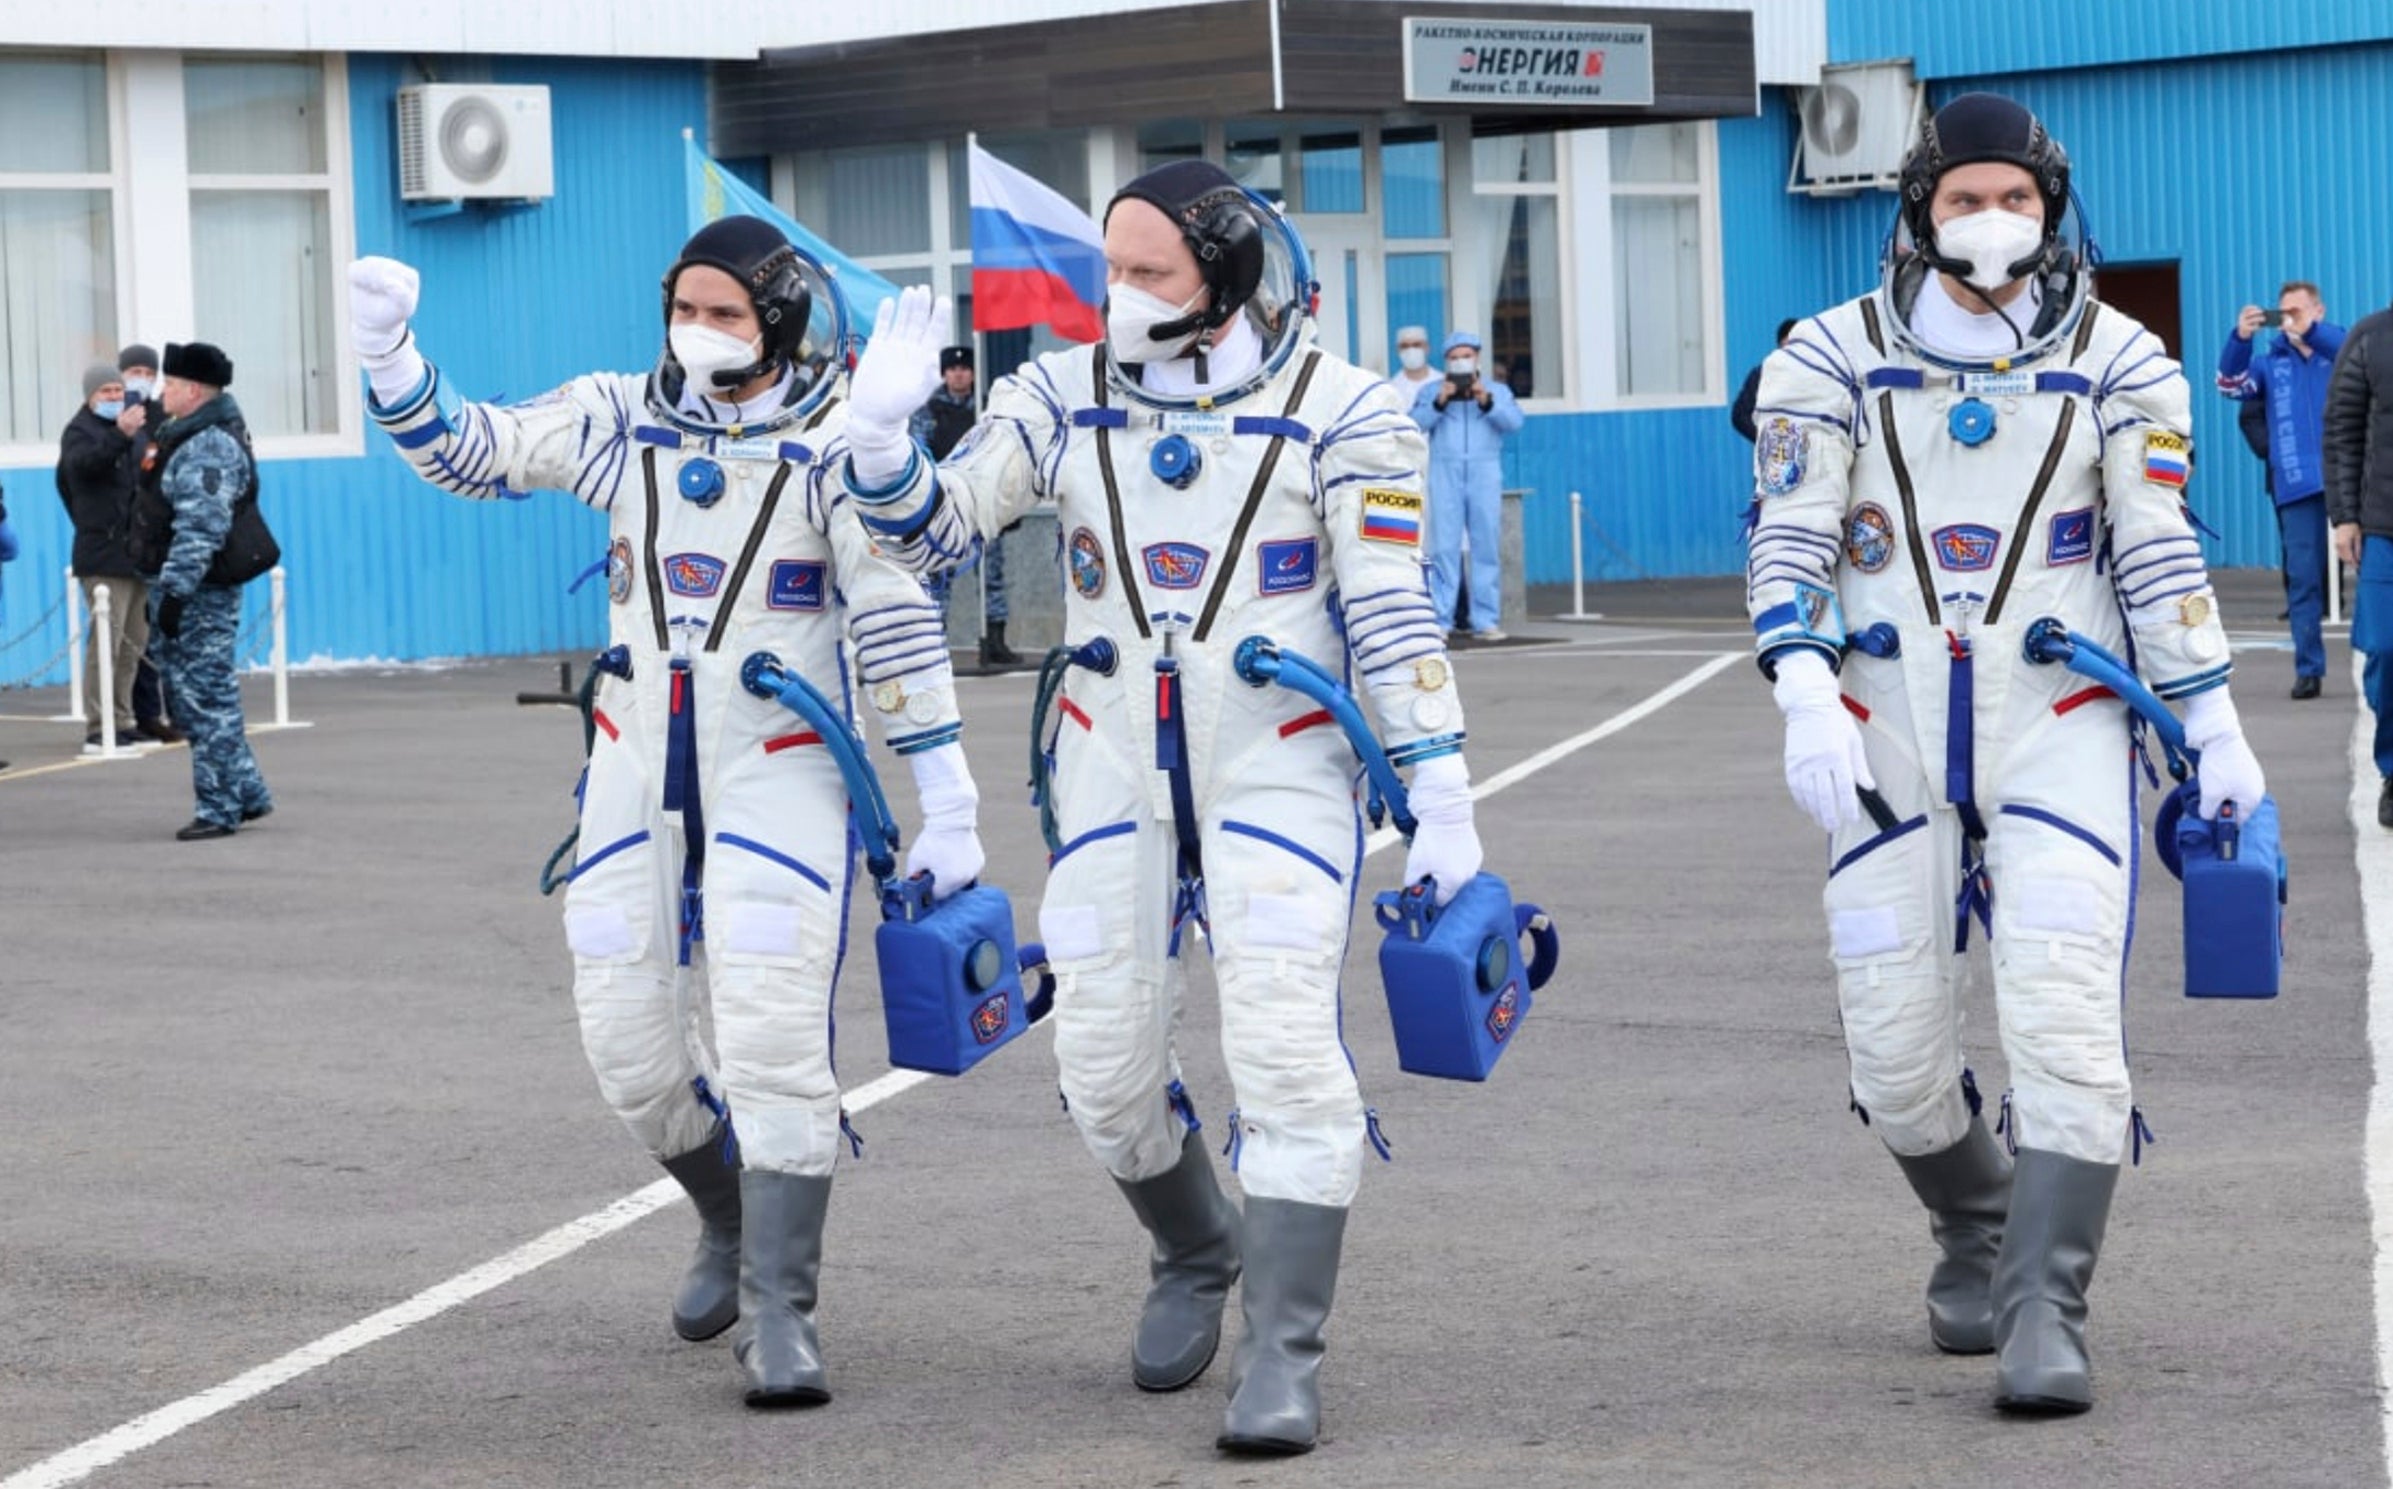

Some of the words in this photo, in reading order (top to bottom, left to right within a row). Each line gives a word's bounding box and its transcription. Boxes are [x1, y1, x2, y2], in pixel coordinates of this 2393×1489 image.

[1414, 26, 1564, 43] РАКЕТНО-КОСМИЧЕСКАЯ
[1566, 30, 1645, 46] КОРПОРАЦИЯ
[1458, 47, 1580, 76] ЭНЕРГИЯ
[1449, 79, 1495, 95] Имени
[1499, 81, 1513, 95] С.
[1516, 81, 1531, 95] П.
[1534, 81, 1602, 98] Королева
